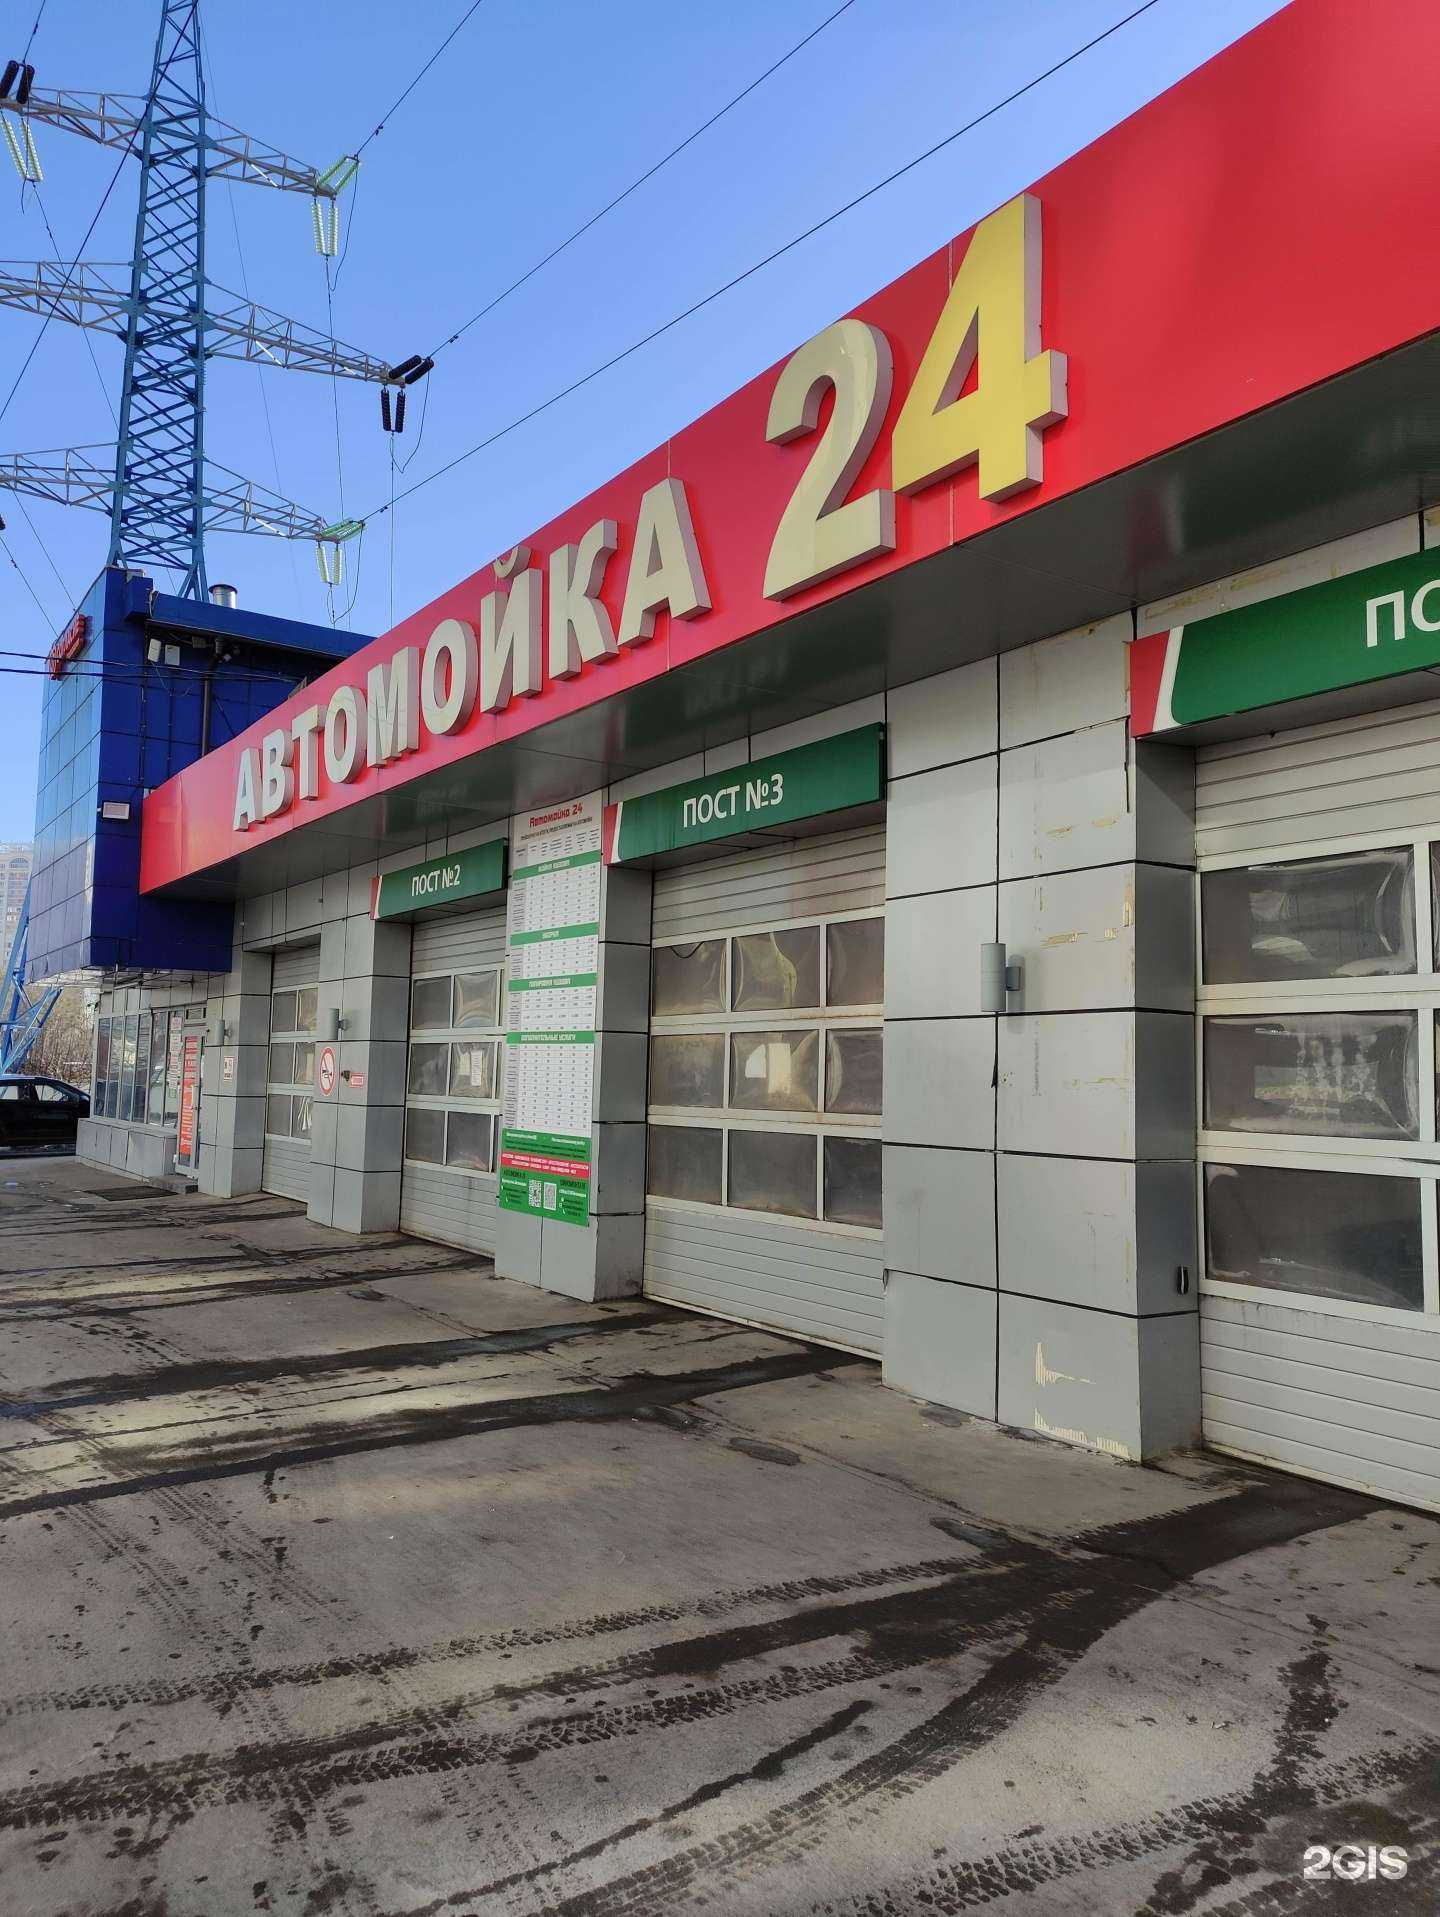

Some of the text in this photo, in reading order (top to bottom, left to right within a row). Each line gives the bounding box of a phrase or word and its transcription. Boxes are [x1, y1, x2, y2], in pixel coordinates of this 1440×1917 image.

[233, 193, 1068, 833] АВТОМОЙКА 24
[572, 802, 583, 816] 24
[683, 773, 784, 828] ПОСТ №3
[411, 864, 461, 897] ПОСТ №2
